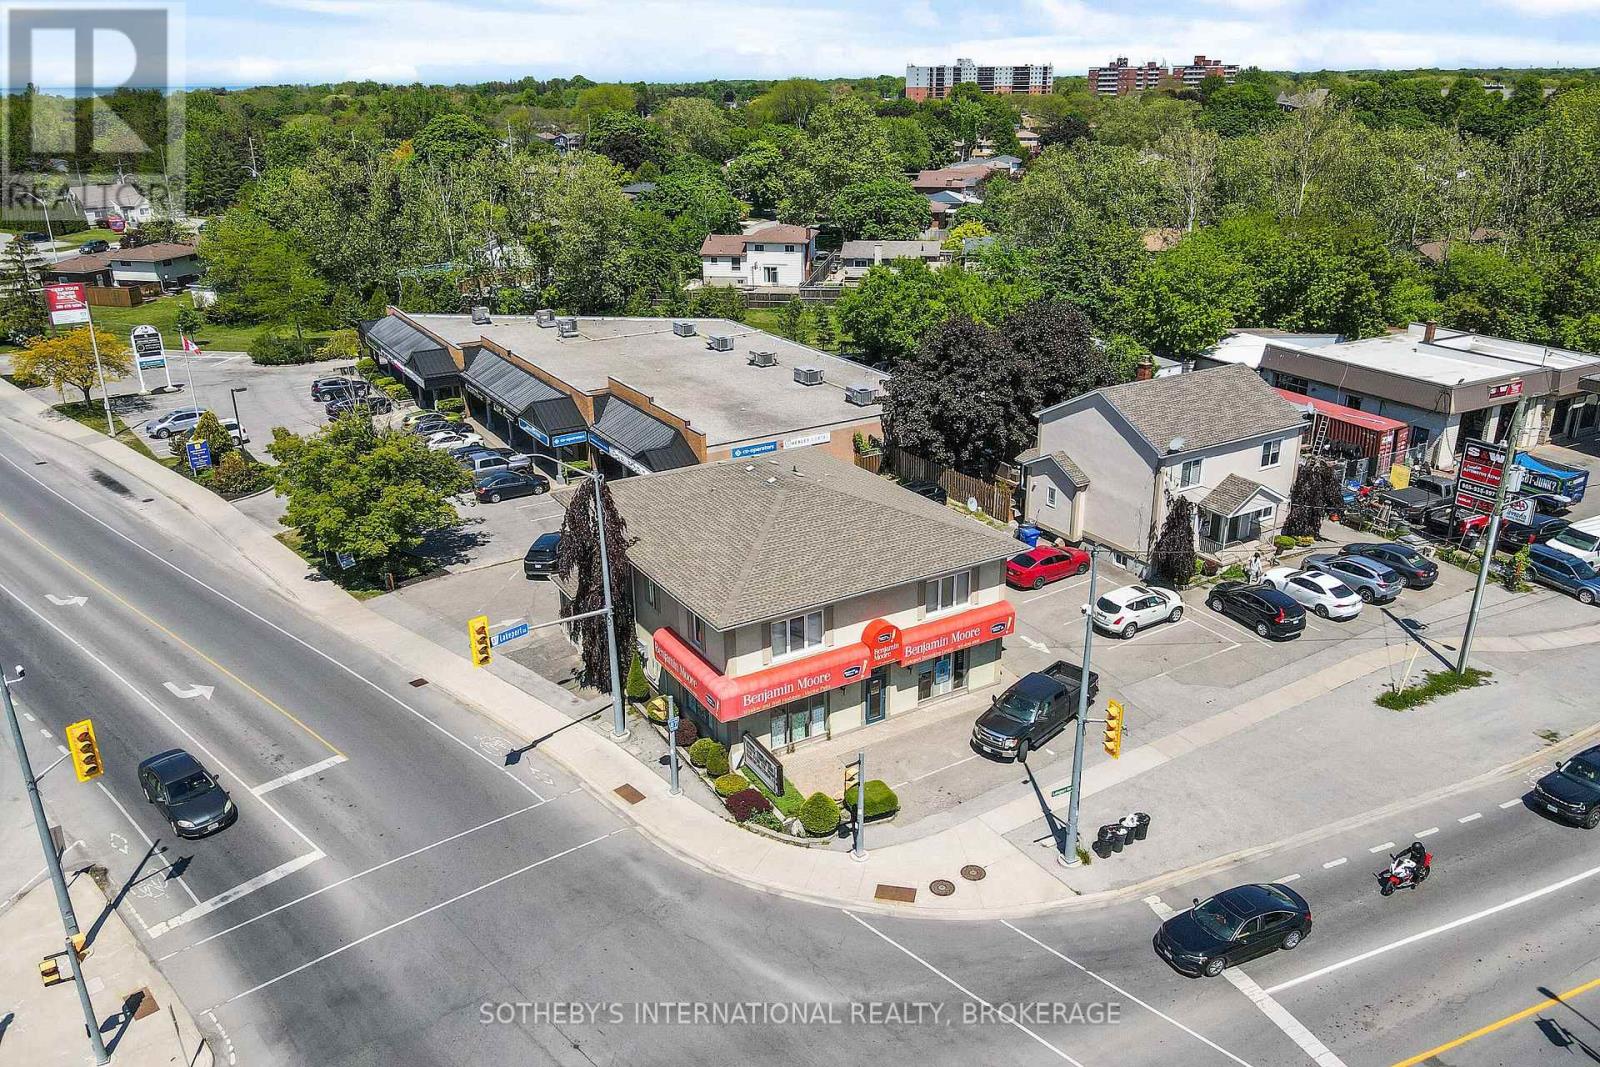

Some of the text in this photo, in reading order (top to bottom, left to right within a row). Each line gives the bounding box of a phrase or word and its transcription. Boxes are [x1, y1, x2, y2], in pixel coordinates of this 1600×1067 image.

[1467, 446, 1480, 457] S
[1489, 452, 1506, 464] W
[500, 627, 523, 642] Lakeport
[904, 636, 949, 657] Benjamin
[951, 627, 981, 644] Moore
[743, 683, 794, 707] Benjamin
[797, 672, 832, 690] Moore
